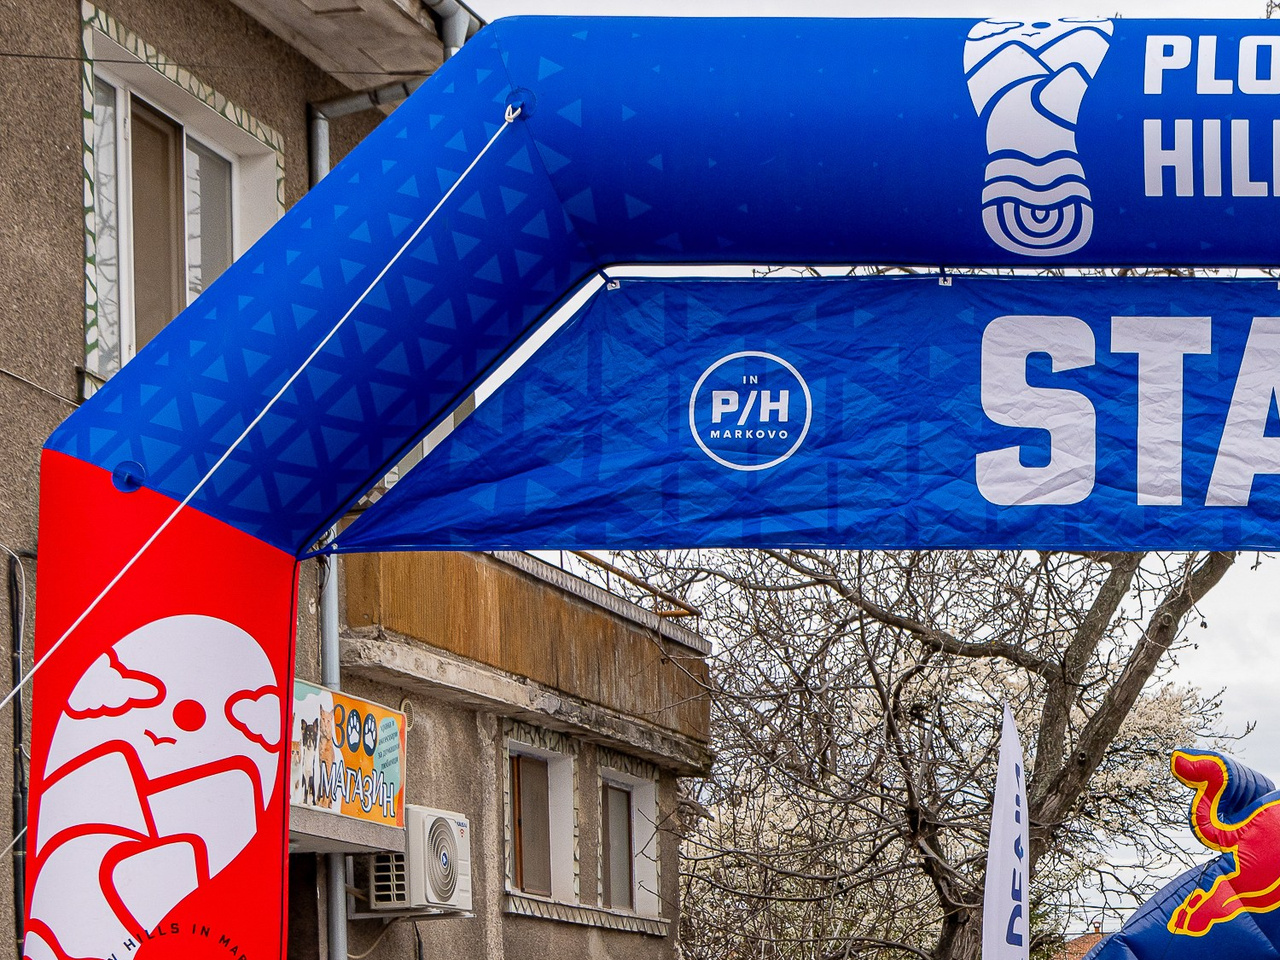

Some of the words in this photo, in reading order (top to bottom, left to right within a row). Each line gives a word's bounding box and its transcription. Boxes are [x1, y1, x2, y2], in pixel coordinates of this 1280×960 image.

[743, 375, 758, 384] IN
[712, 390, 789, 425] P/H
[711, 429, 788, 439] MARKOVO
[320, 759, 395, 817] МАГАЗИН
[123, 923, 180, 951] HILLS
[192, 923, 210, 937] IN
